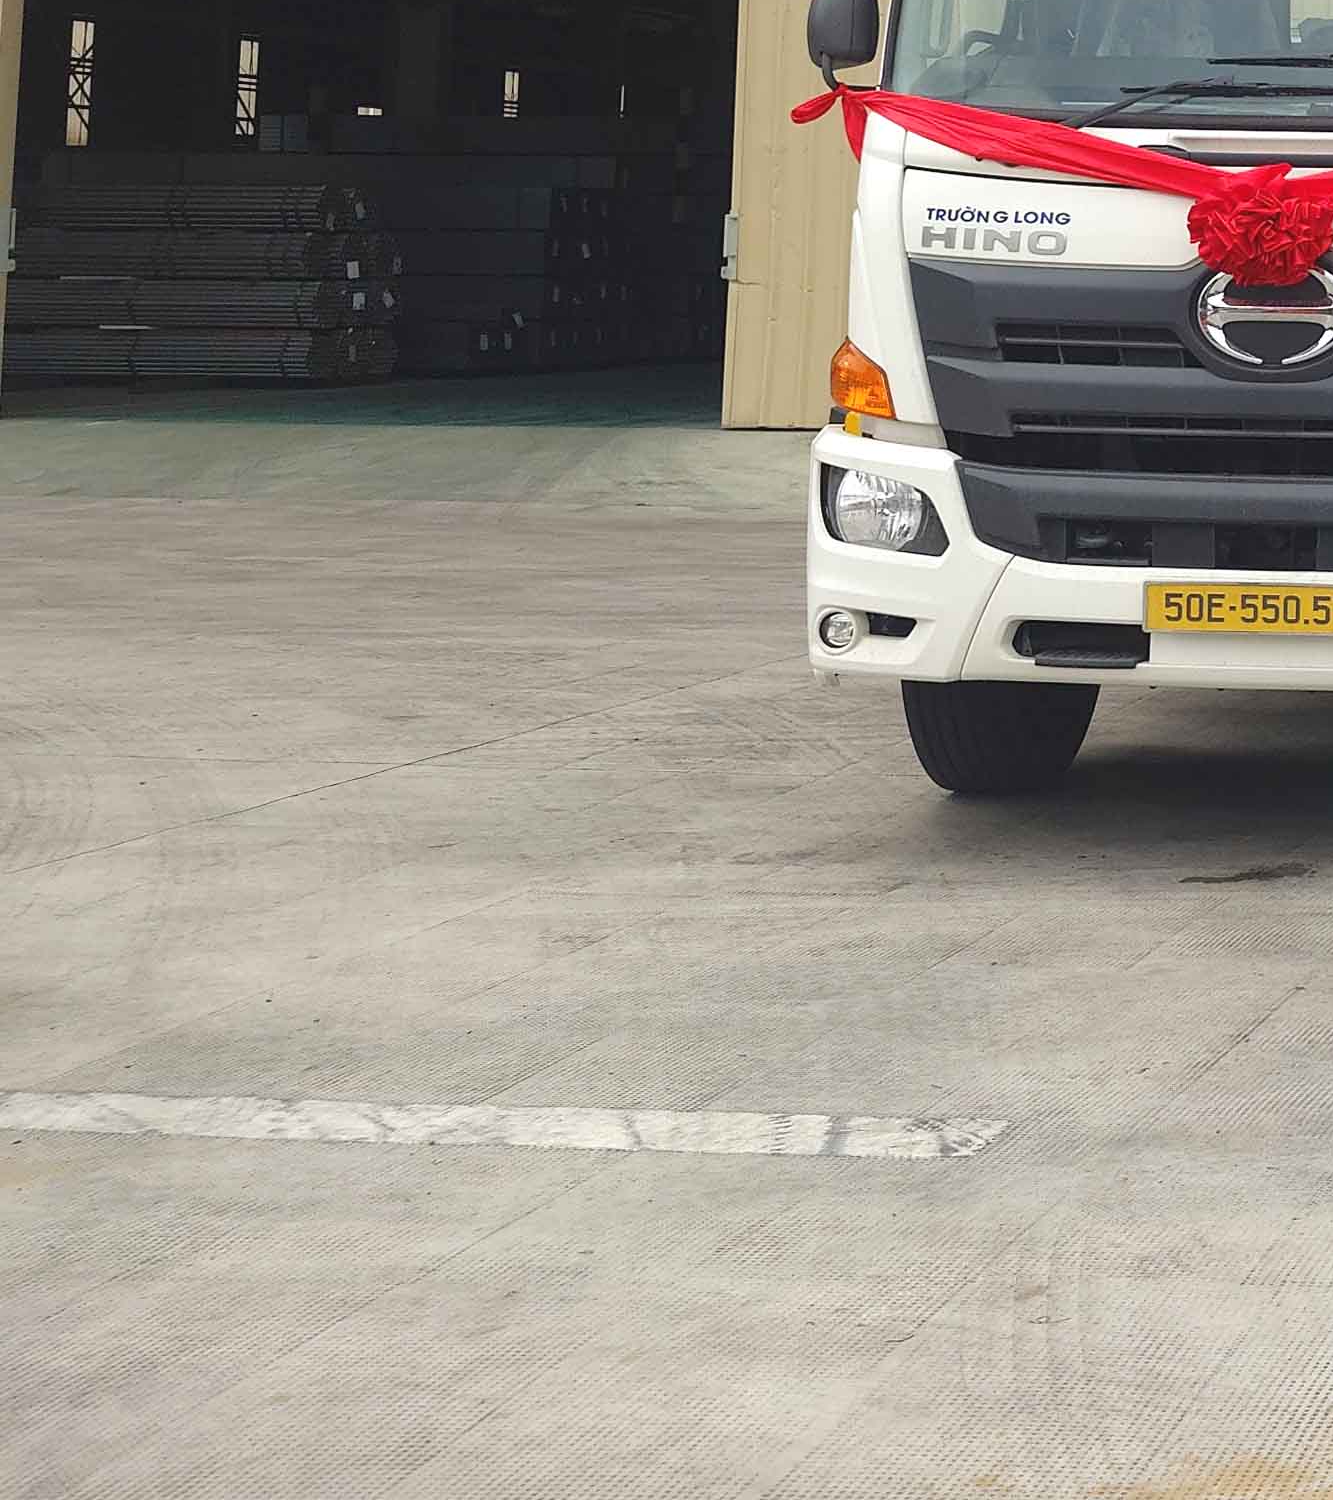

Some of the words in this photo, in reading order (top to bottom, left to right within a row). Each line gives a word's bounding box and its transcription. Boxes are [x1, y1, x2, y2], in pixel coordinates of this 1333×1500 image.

[926, 206, 1009, 224] TRƯỜNG
[1013, 210, 1072, 225] LONG
[921, 225, 1068, 256] HINO
